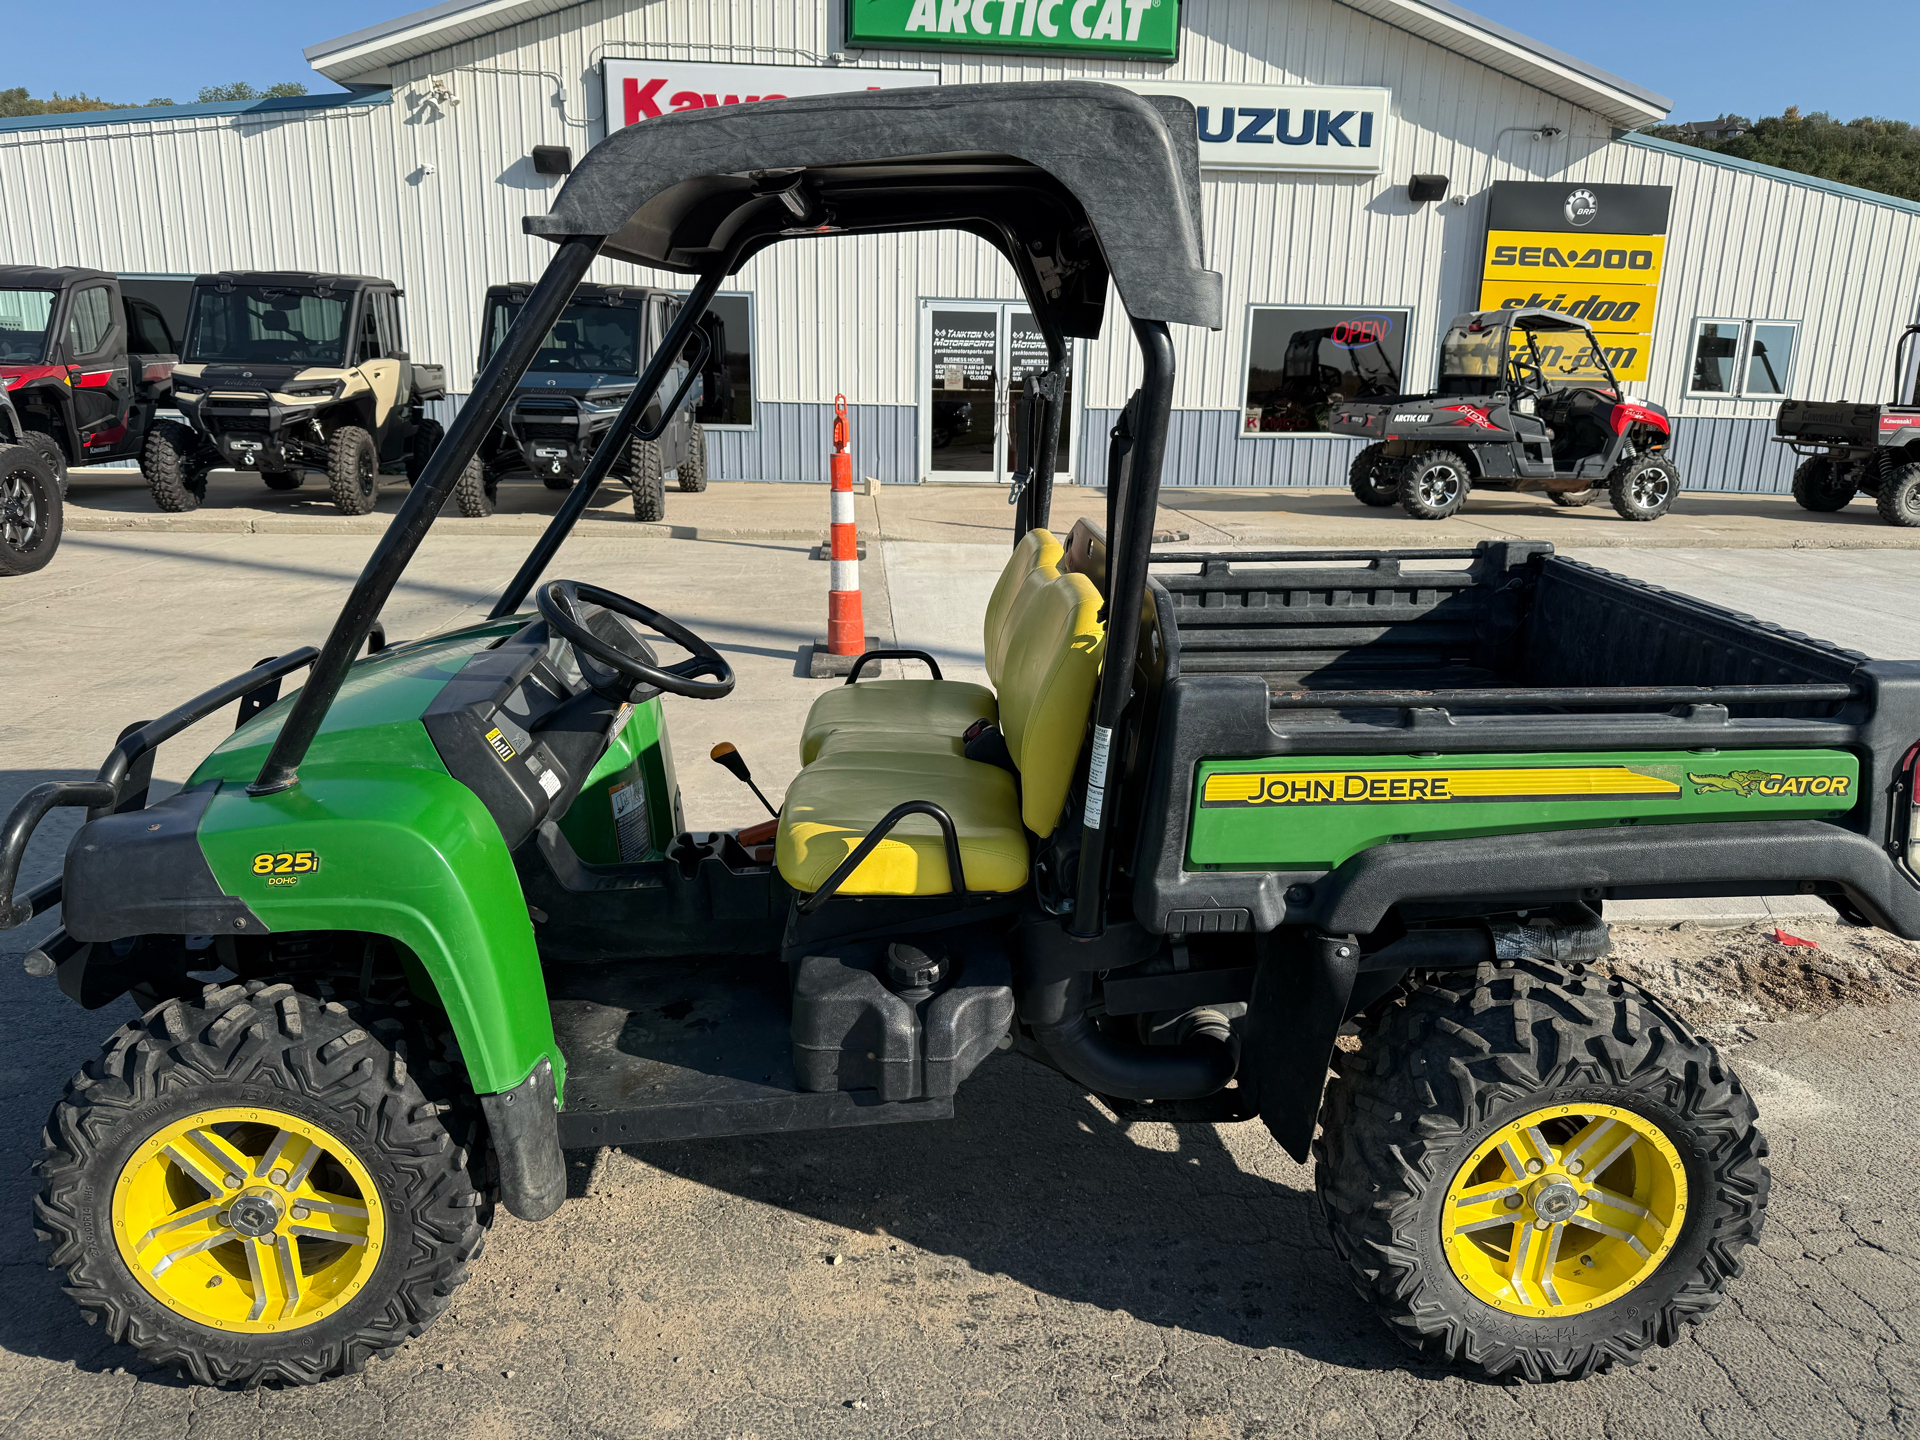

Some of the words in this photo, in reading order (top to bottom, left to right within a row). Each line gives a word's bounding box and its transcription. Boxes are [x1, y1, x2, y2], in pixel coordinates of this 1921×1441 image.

[904, 0, 1068, 37] ARCTIC
[1071, 0, 1151, 42] CAT
[1197, 105, 1374, 148] UZUKI
[947, 329, 983, 338] YANKTON
[1332, 320, 1387, 343] OPEN
[1394, 414, 1417, 423] ARCTIC
[1417, 414, 1430, 423] CAT
[1458, 405, 1490, 428] HDX
[1883, 417, 1912, 425] Kawasaki
[1248, 776, 1335, 801] JOHN
[1343, 775, 1450, 799] DEERE
[1758, 774, 1850, 796] GATOR
[252, 851, 319, 875] 825i
[268, 876, 297, 886] DOHC
[240, 1086, 384, 1163] BIGHORN
